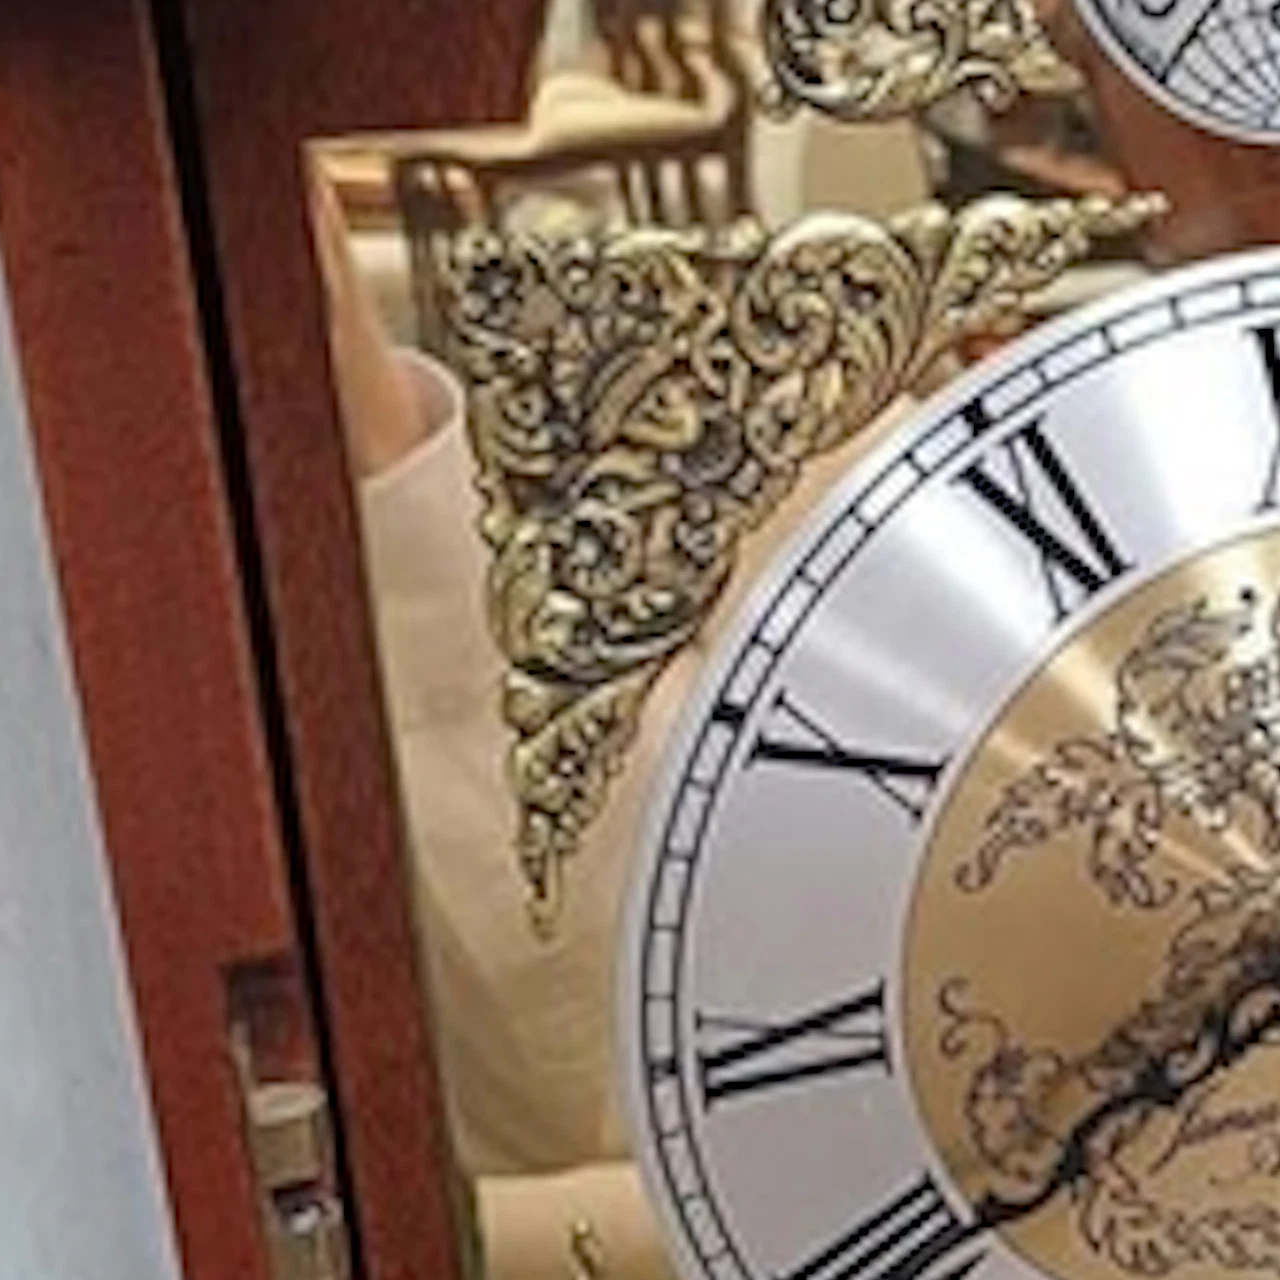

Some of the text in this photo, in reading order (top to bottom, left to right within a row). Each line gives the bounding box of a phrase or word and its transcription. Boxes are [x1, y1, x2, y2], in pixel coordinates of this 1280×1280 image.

[947, 414, 1139, 626] XI
[744, 687, 953, 823] X
[694, 977, 893, 1111] IX
